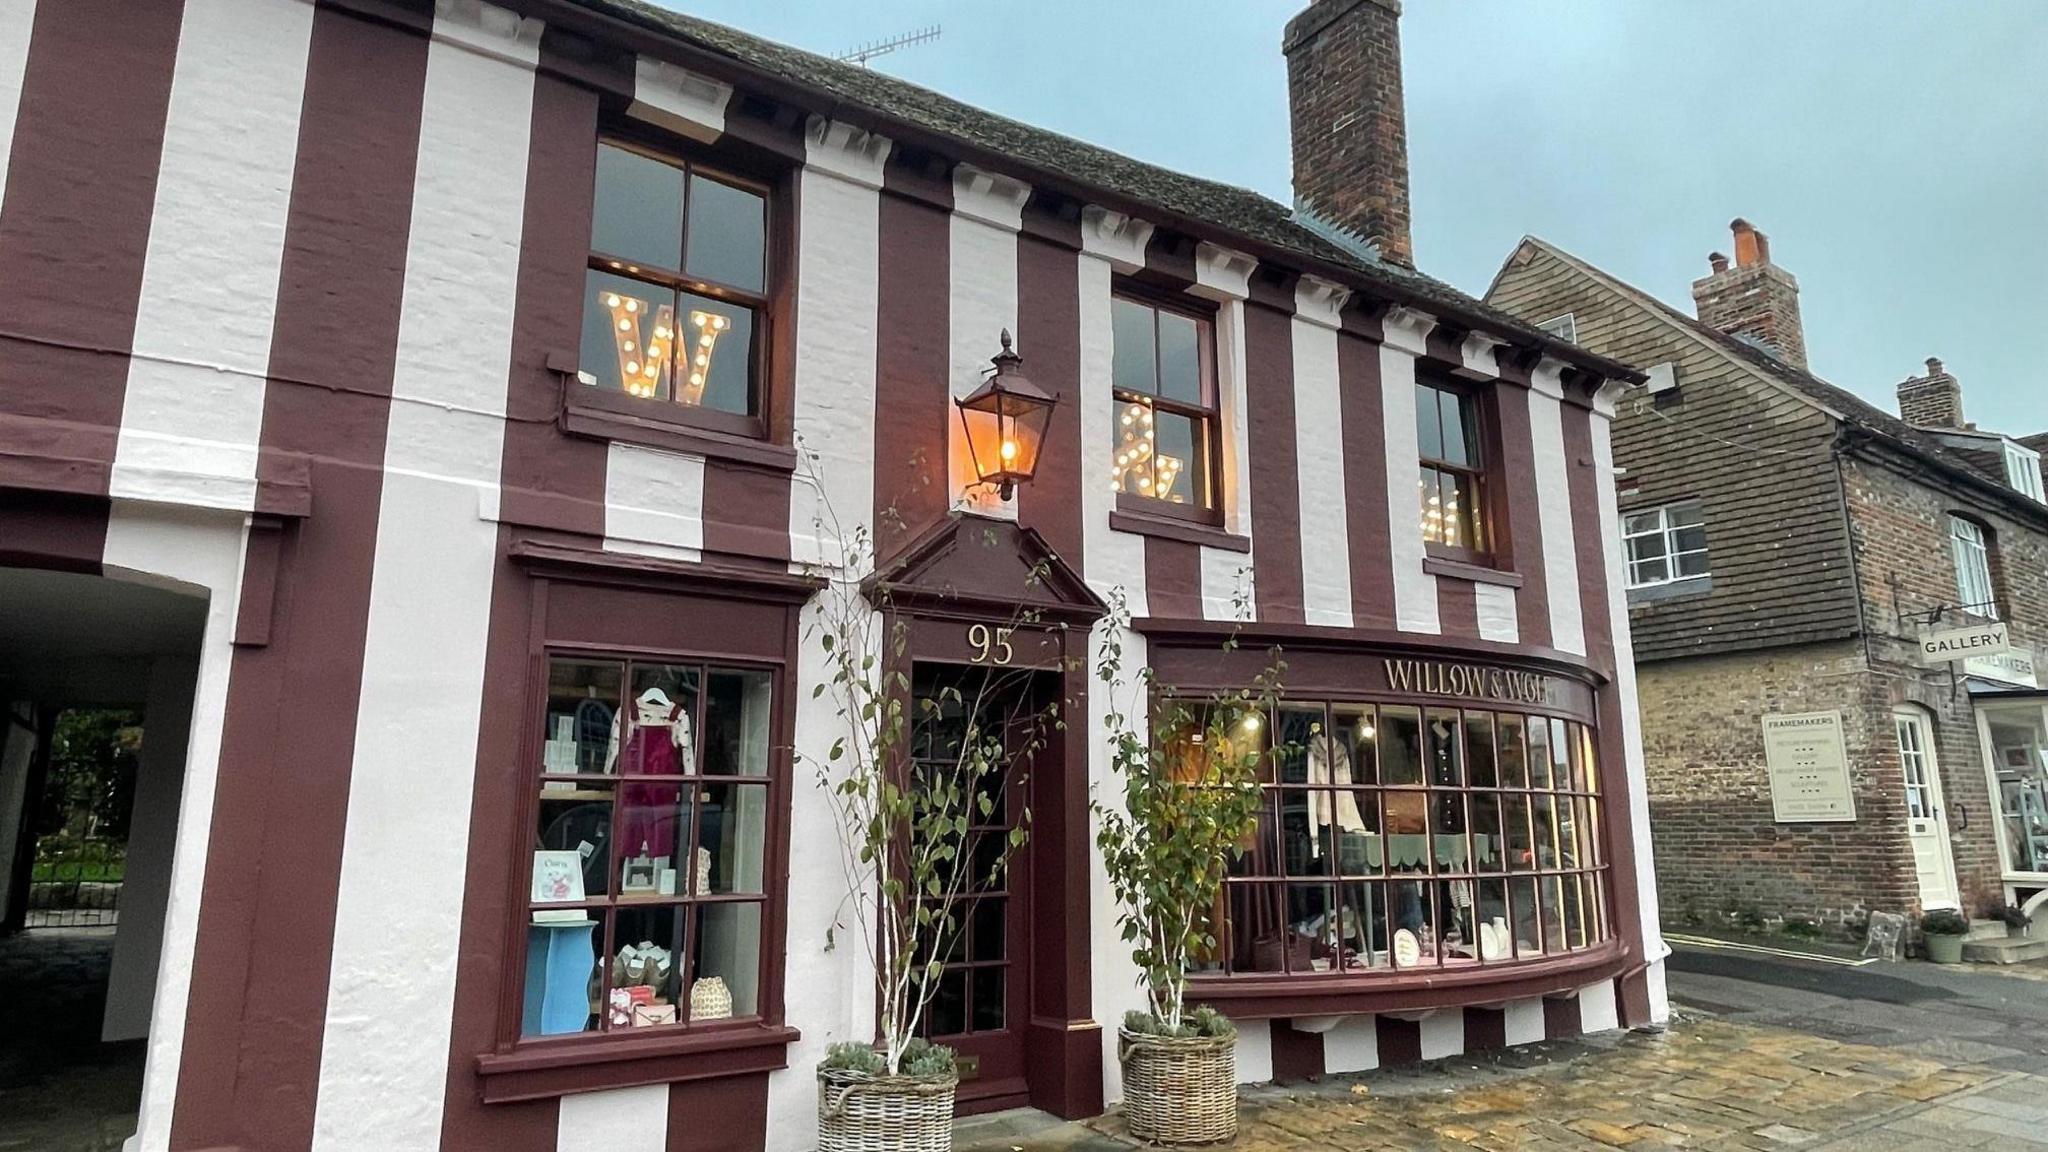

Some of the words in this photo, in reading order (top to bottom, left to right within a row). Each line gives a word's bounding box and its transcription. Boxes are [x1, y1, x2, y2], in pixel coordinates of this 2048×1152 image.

[599, 291, 731, 406] W
[968, 624, 1013, 664] 95
[1925, 633, 2003, 653] GALLERY
[1385, 659, 1486, 697] WILLOW
[1490, 670, 1503, 698] &
[1505, 670, 1552, 705] WOLF
[1768, 717, 1834, 729] FRAMEMAKERS
